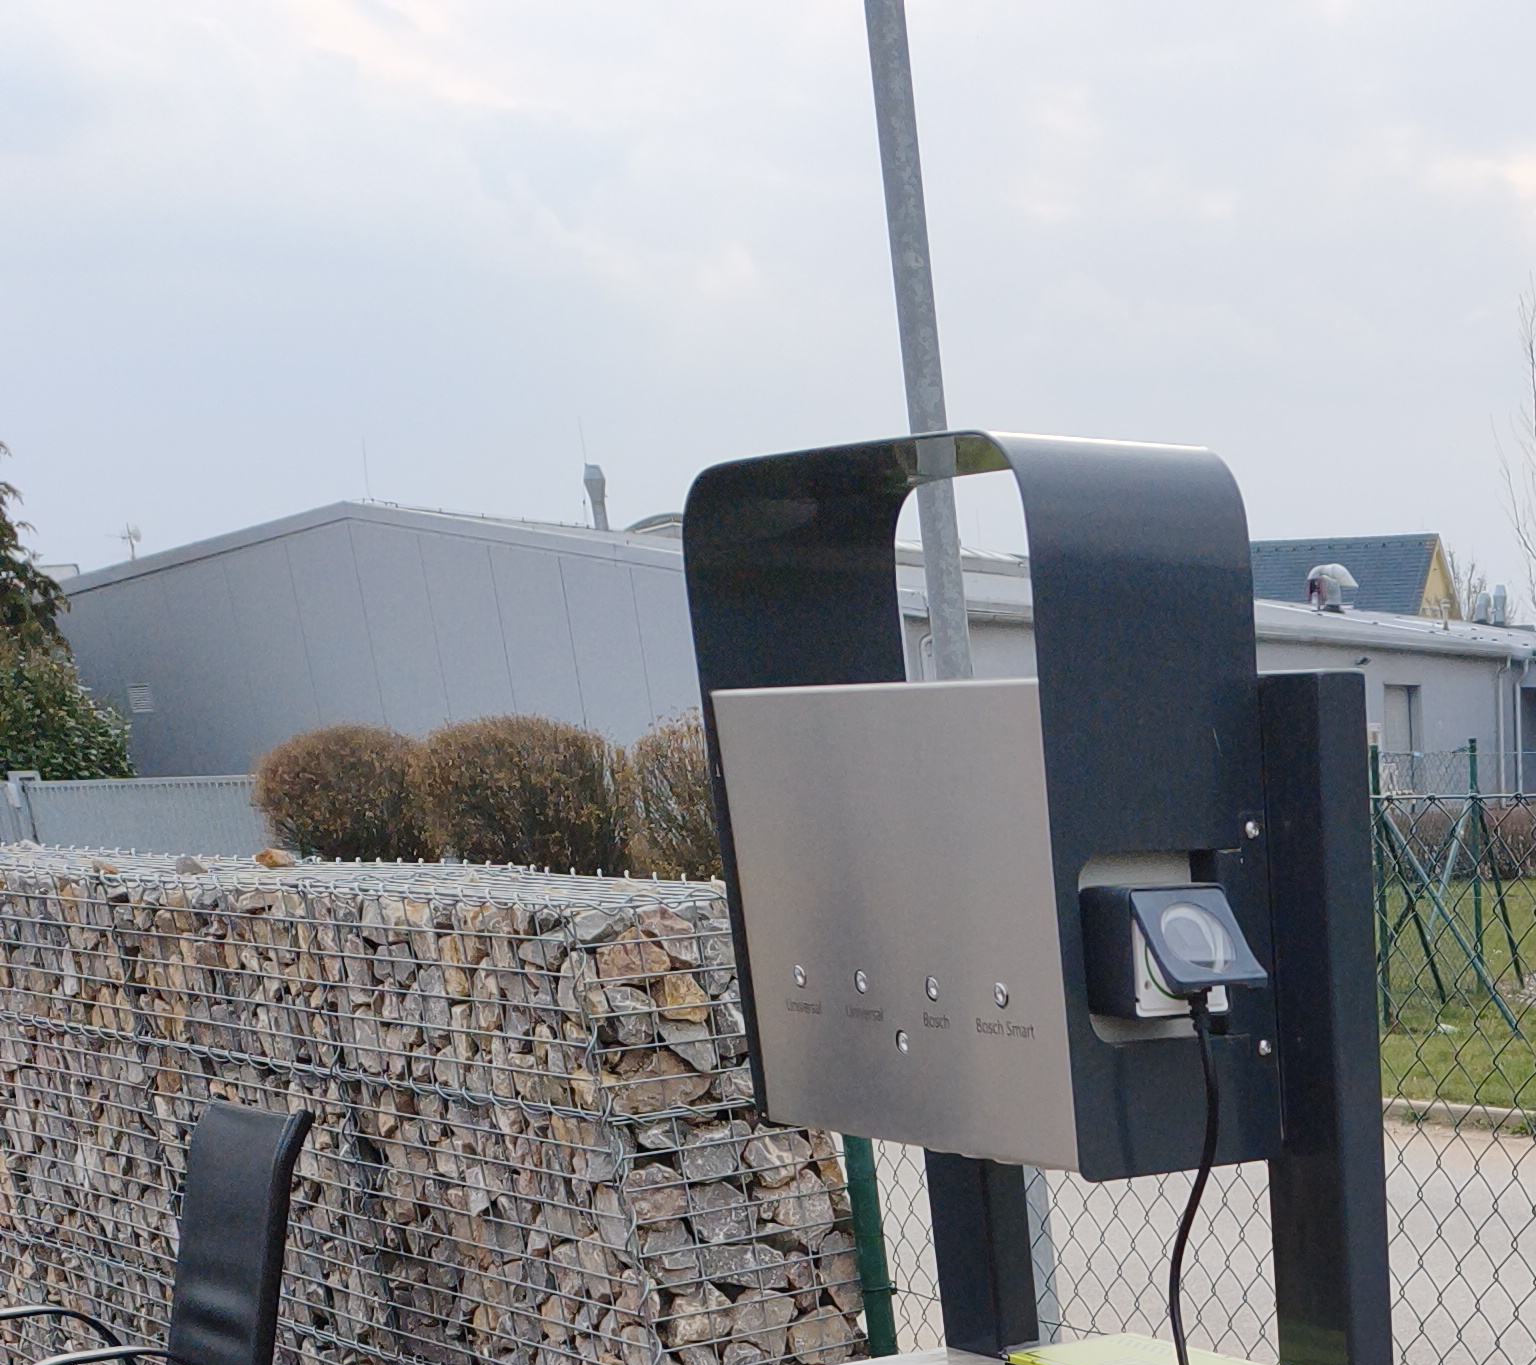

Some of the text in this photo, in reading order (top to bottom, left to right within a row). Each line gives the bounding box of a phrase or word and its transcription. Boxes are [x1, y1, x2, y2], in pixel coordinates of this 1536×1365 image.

[923, 1012, 950, 1029] Bosch
[976, 1017, 1035, 1040] Bosch Smart
